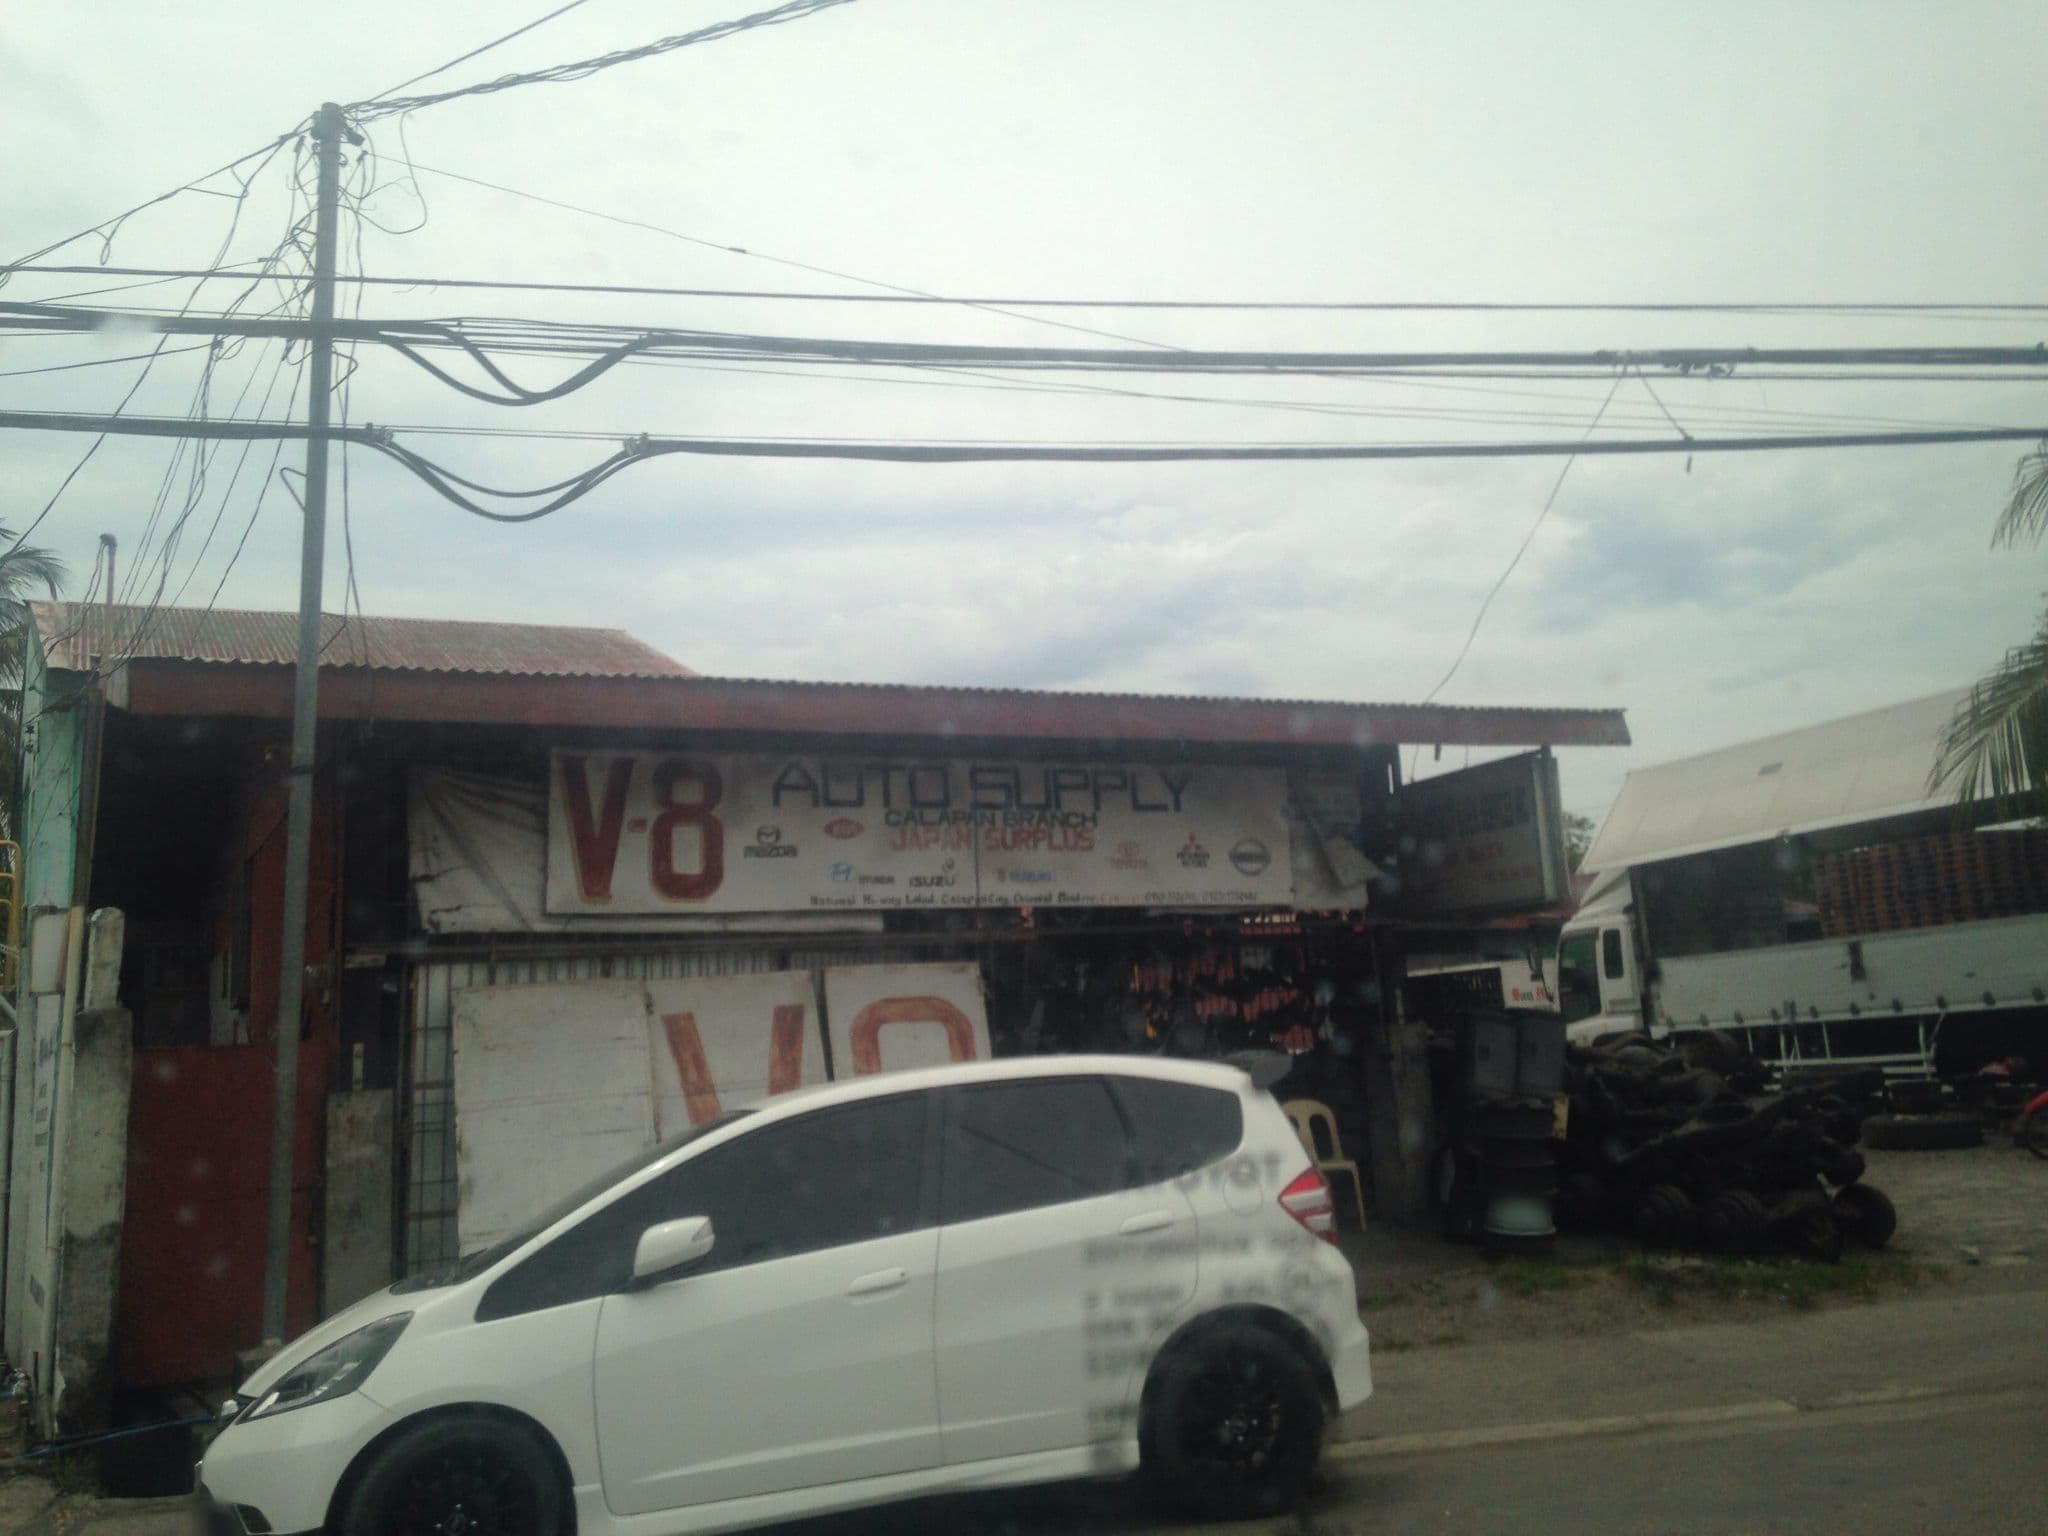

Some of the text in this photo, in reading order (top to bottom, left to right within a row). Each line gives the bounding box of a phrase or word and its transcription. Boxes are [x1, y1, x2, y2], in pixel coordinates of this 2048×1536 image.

[772, 762, 1192, 812] AUTO SUPPLY
[563, 754, 726, 904] V-8
[884, 810, 1098, 828] CALAPAN BRANCH
[889, 828, 974, 851] JAPAN
[983, 827, 1096, 852] SURPLUS
